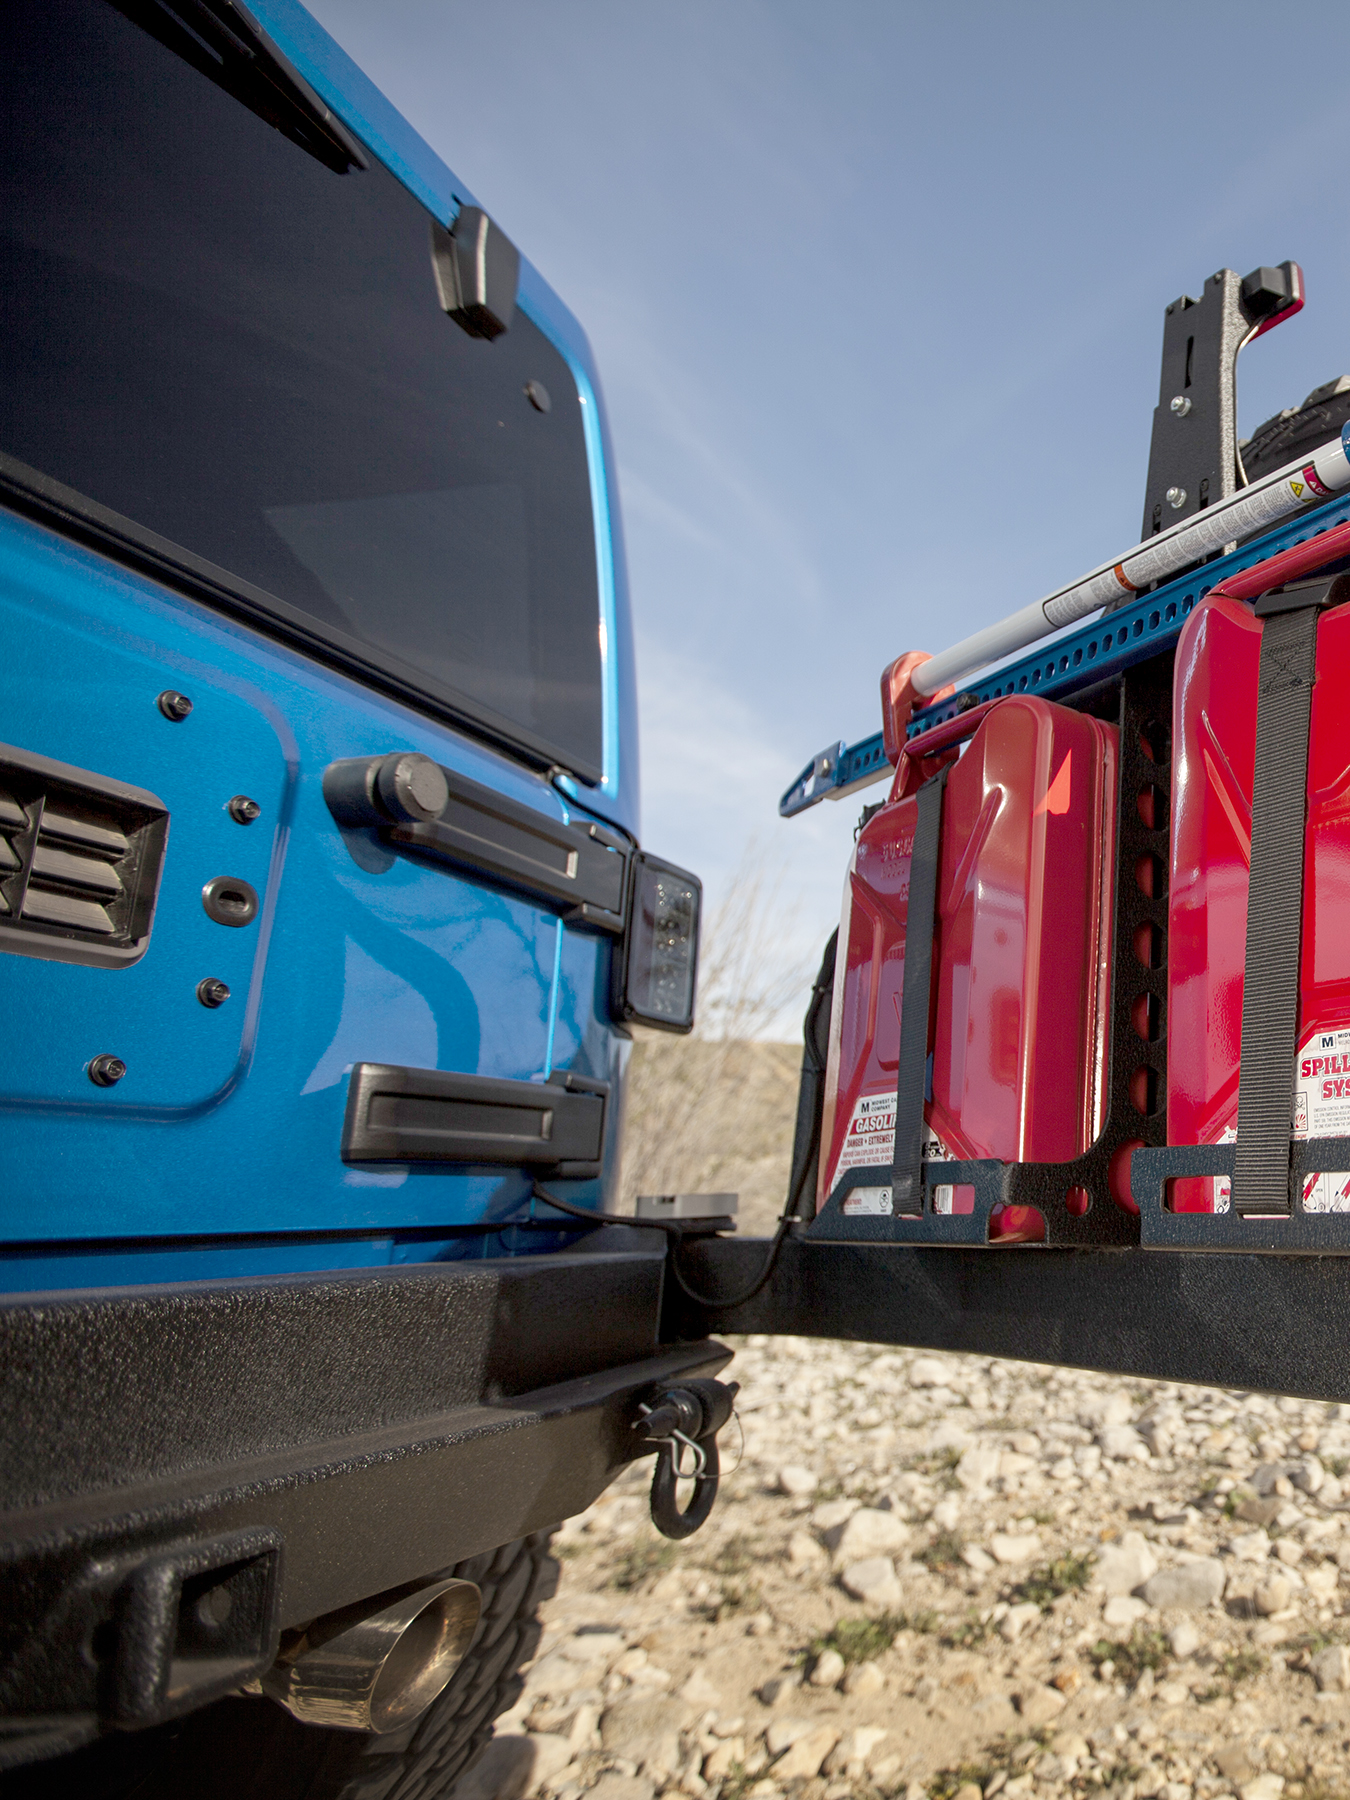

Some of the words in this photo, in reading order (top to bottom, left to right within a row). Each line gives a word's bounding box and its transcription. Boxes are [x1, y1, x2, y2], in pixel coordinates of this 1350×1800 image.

[1321, 1037, 1334, 1048] M
[861, 1102, 870, 1113] M
[871, 1104, 890, 1112] COMPANY
[847, 1137, 864, 1148] DANGER
[868, 1134, 893, 1146] EXTREMELY
